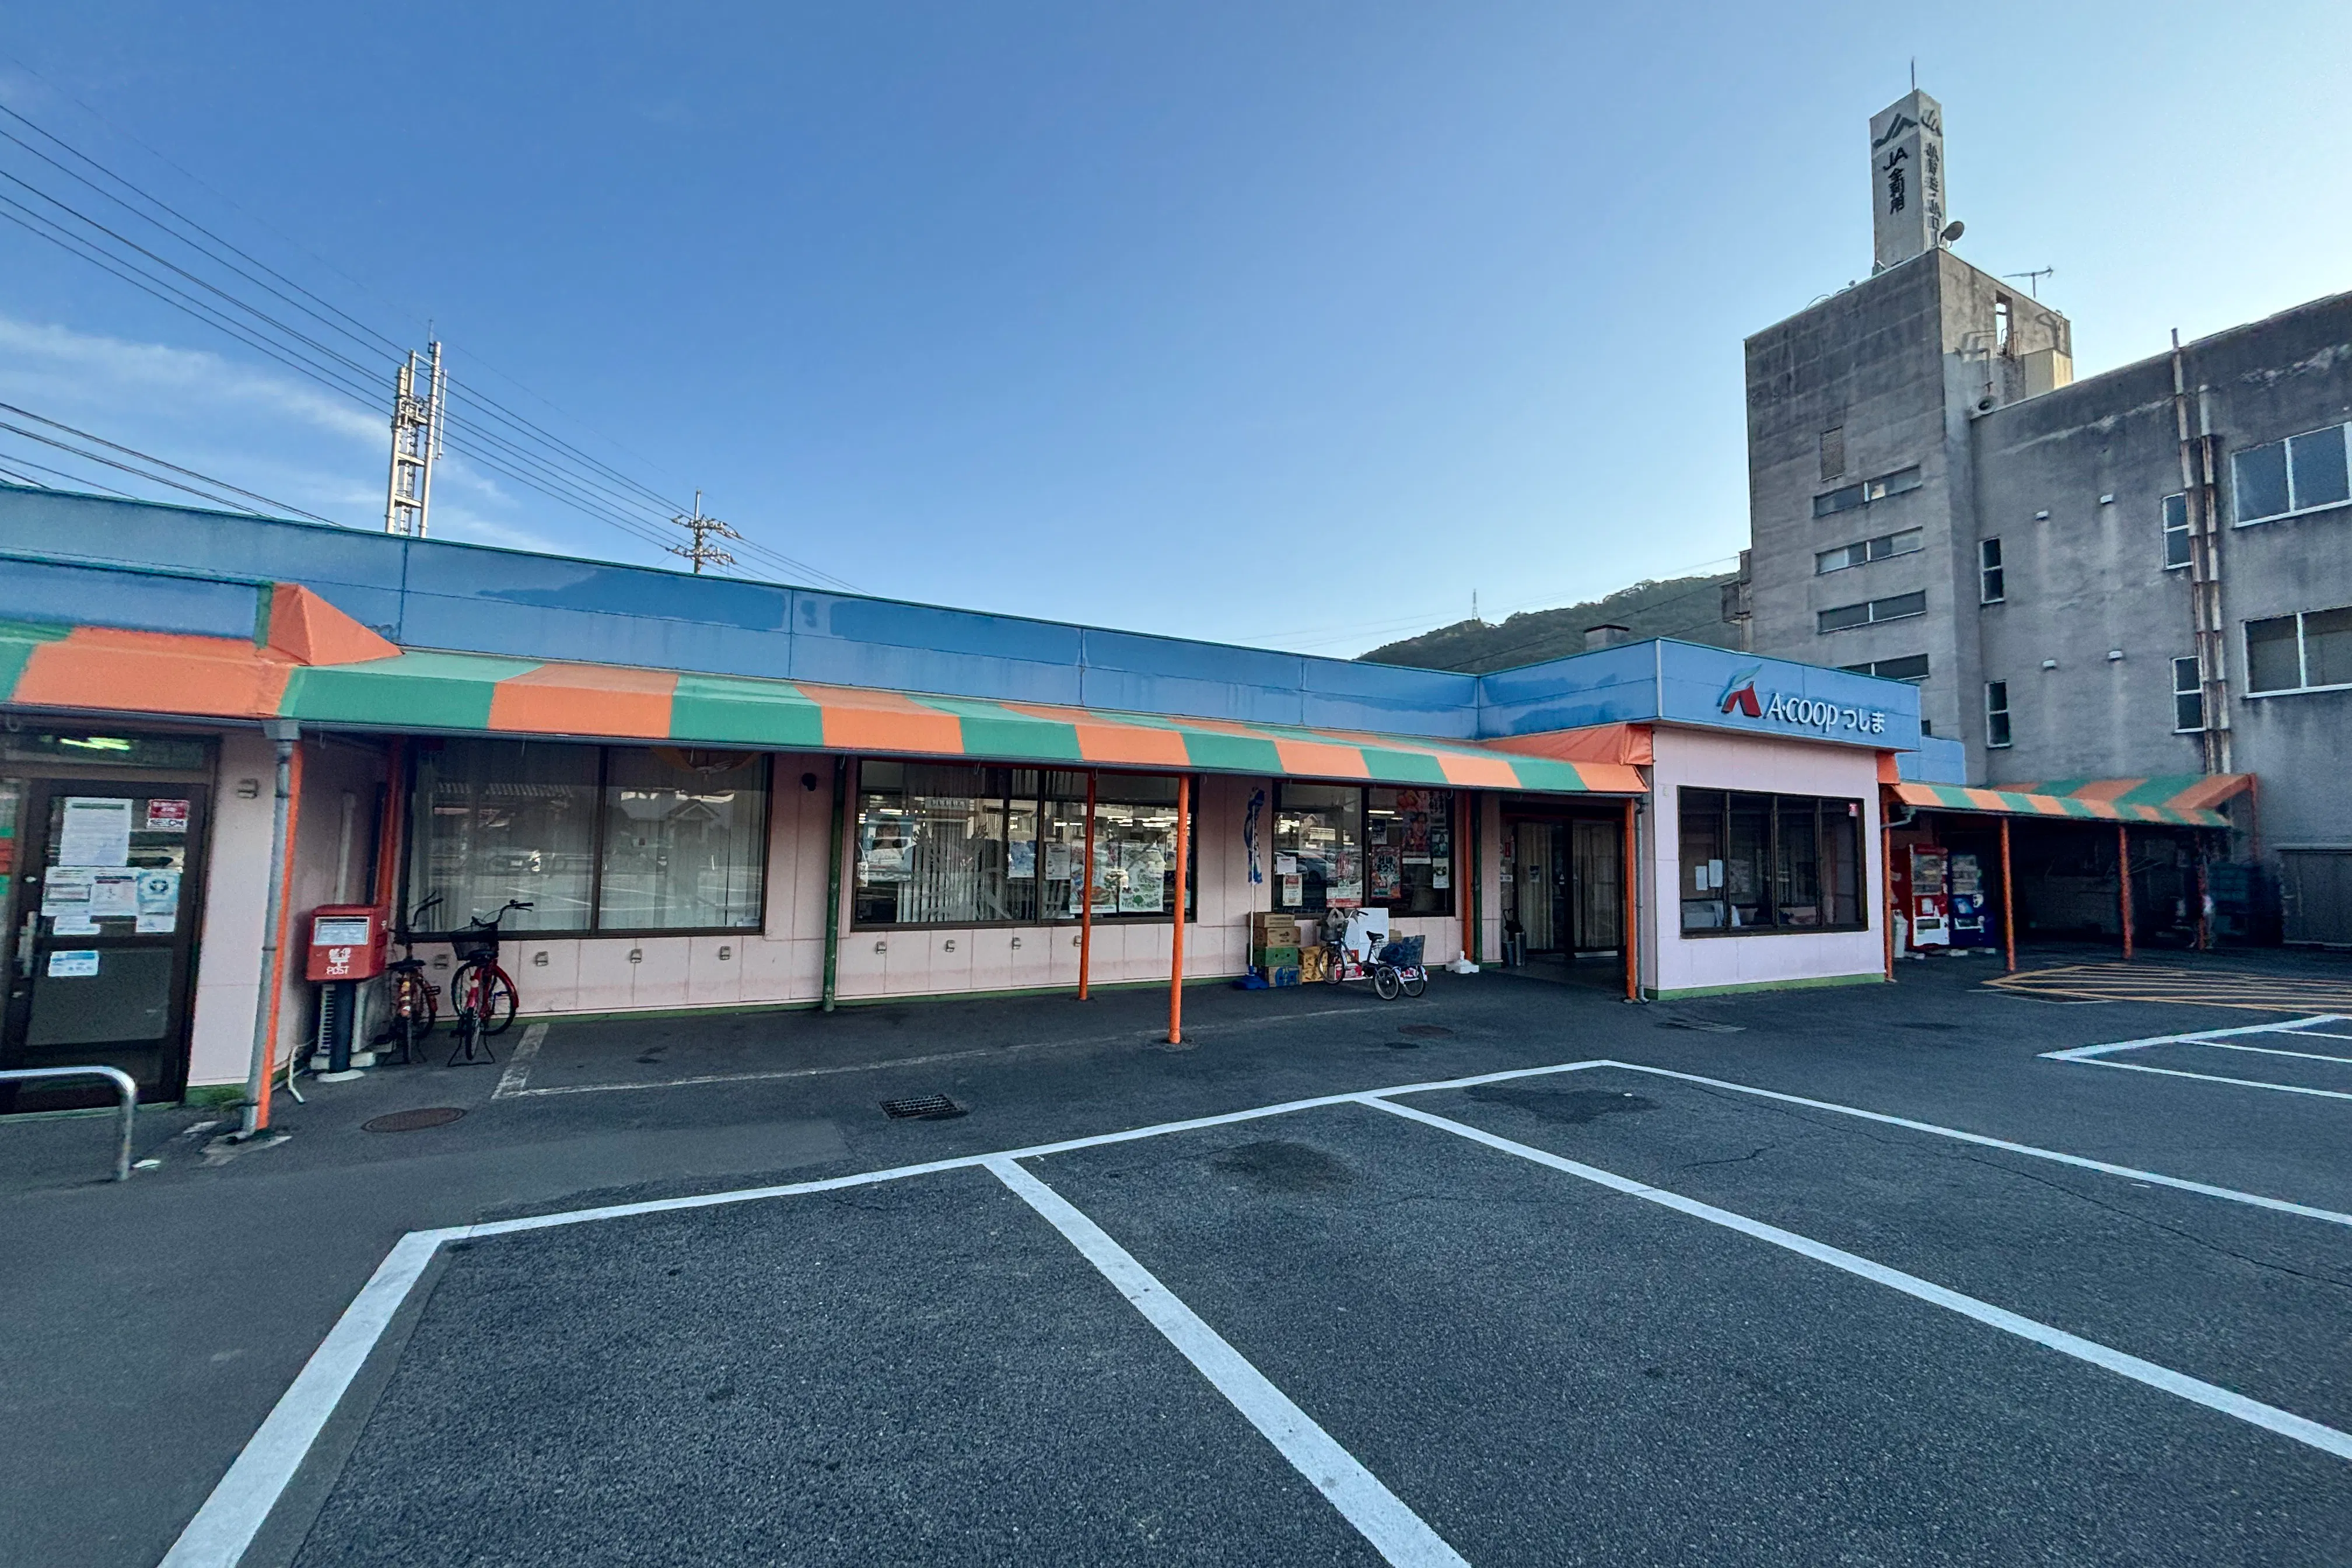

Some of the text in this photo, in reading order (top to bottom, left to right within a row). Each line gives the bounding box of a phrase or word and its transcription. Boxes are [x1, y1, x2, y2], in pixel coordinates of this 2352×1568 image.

[1842, 708, 1885, 733] つしま
[326, 965, 350, 975] POST
